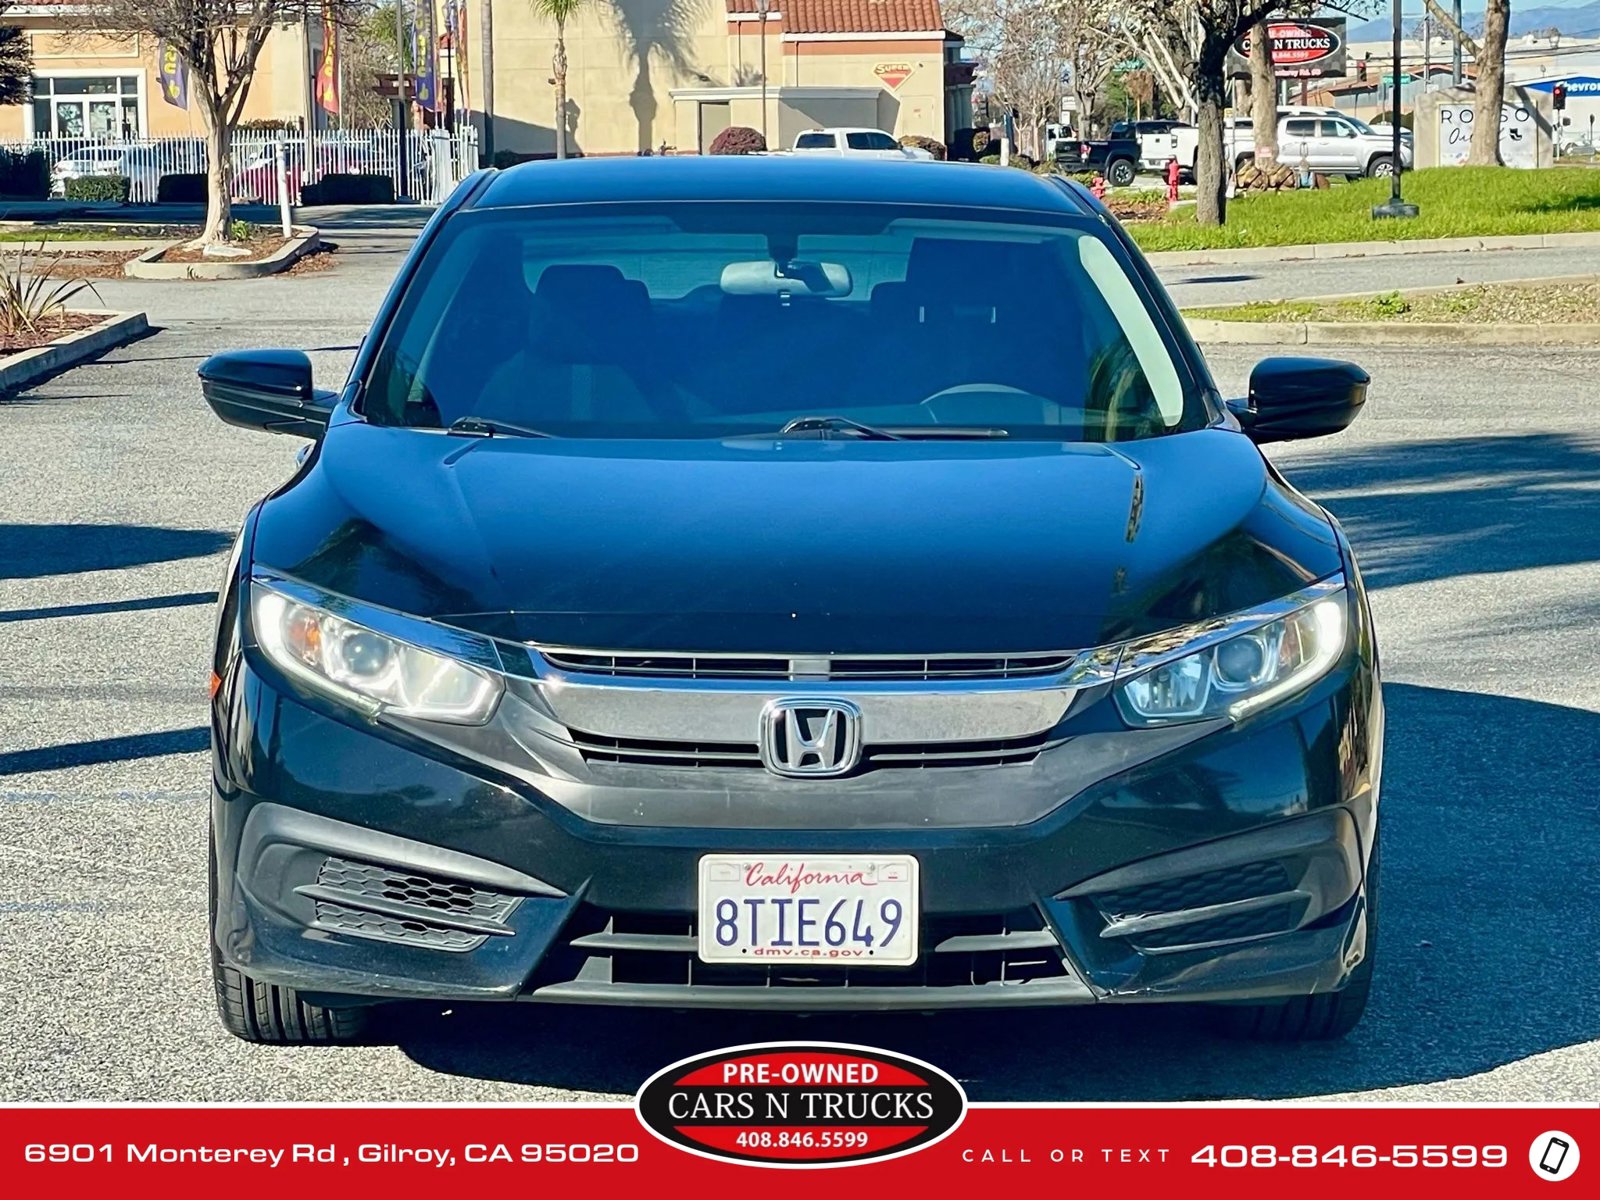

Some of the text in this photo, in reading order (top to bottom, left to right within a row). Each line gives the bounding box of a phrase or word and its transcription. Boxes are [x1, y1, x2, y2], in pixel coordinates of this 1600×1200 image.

[1274, 39, 1331, 49] N TRUCKS
[1555, 80, 1600, 92] hevro
[1441, 108, 1530, 123] ROSO
[746, 863, 878, 894] California
[716, 898, 902, 947] 8TIE649
[753, 947, 864, 958] dmv.ca.gov
